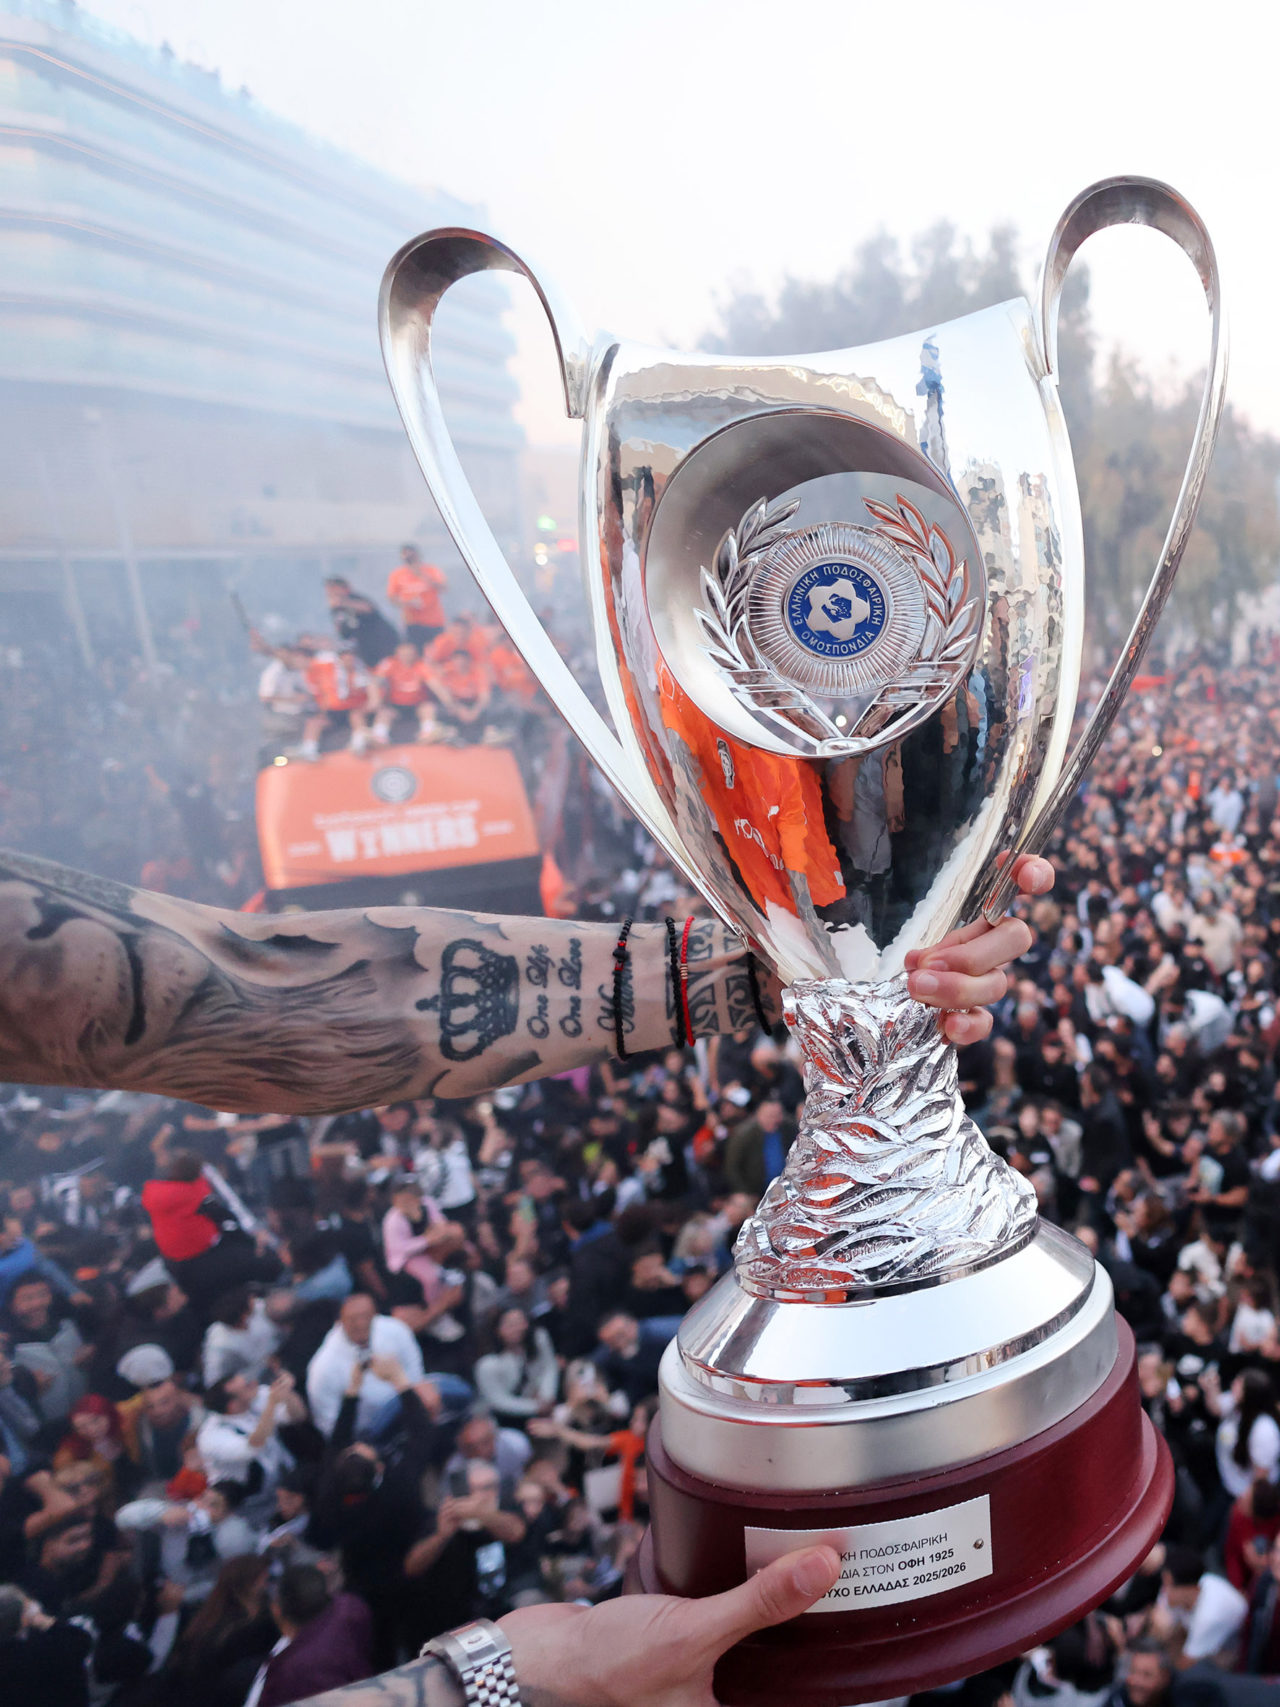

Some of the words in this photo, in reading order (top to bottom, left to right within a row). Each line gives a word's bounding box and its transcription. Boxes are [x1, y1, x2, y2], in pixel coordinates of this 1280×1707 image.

[791, 570, 820, 626] ΕΛΛΗΝΙΚΗ
[823, 565, 883, 626] ΠΟΔΟΣΦΑΙΡΙΚΗ
[800, 631, 876, 655] ΟΜΟΣΠΟΝΔΙΑ
[557, 938, 582, 990] Love
[526, 994, 550, 1039] One
[558, 995, 583, 1038] One
[860, 1532, 948, 1559] ΠΟΔΟΣΦΑΙΡΙΚΗ
[863, 1563, 895, 1577] ΣΤΟΝ
[898, 1556, 925, 1571] ΟΦΗ
[929, 1548, 955, 1564] 1925
[854, 1578, 910, 1596] ΕΛΛΑΔΑΣ
[913, 1562, 967, 1586] 2025/2026
